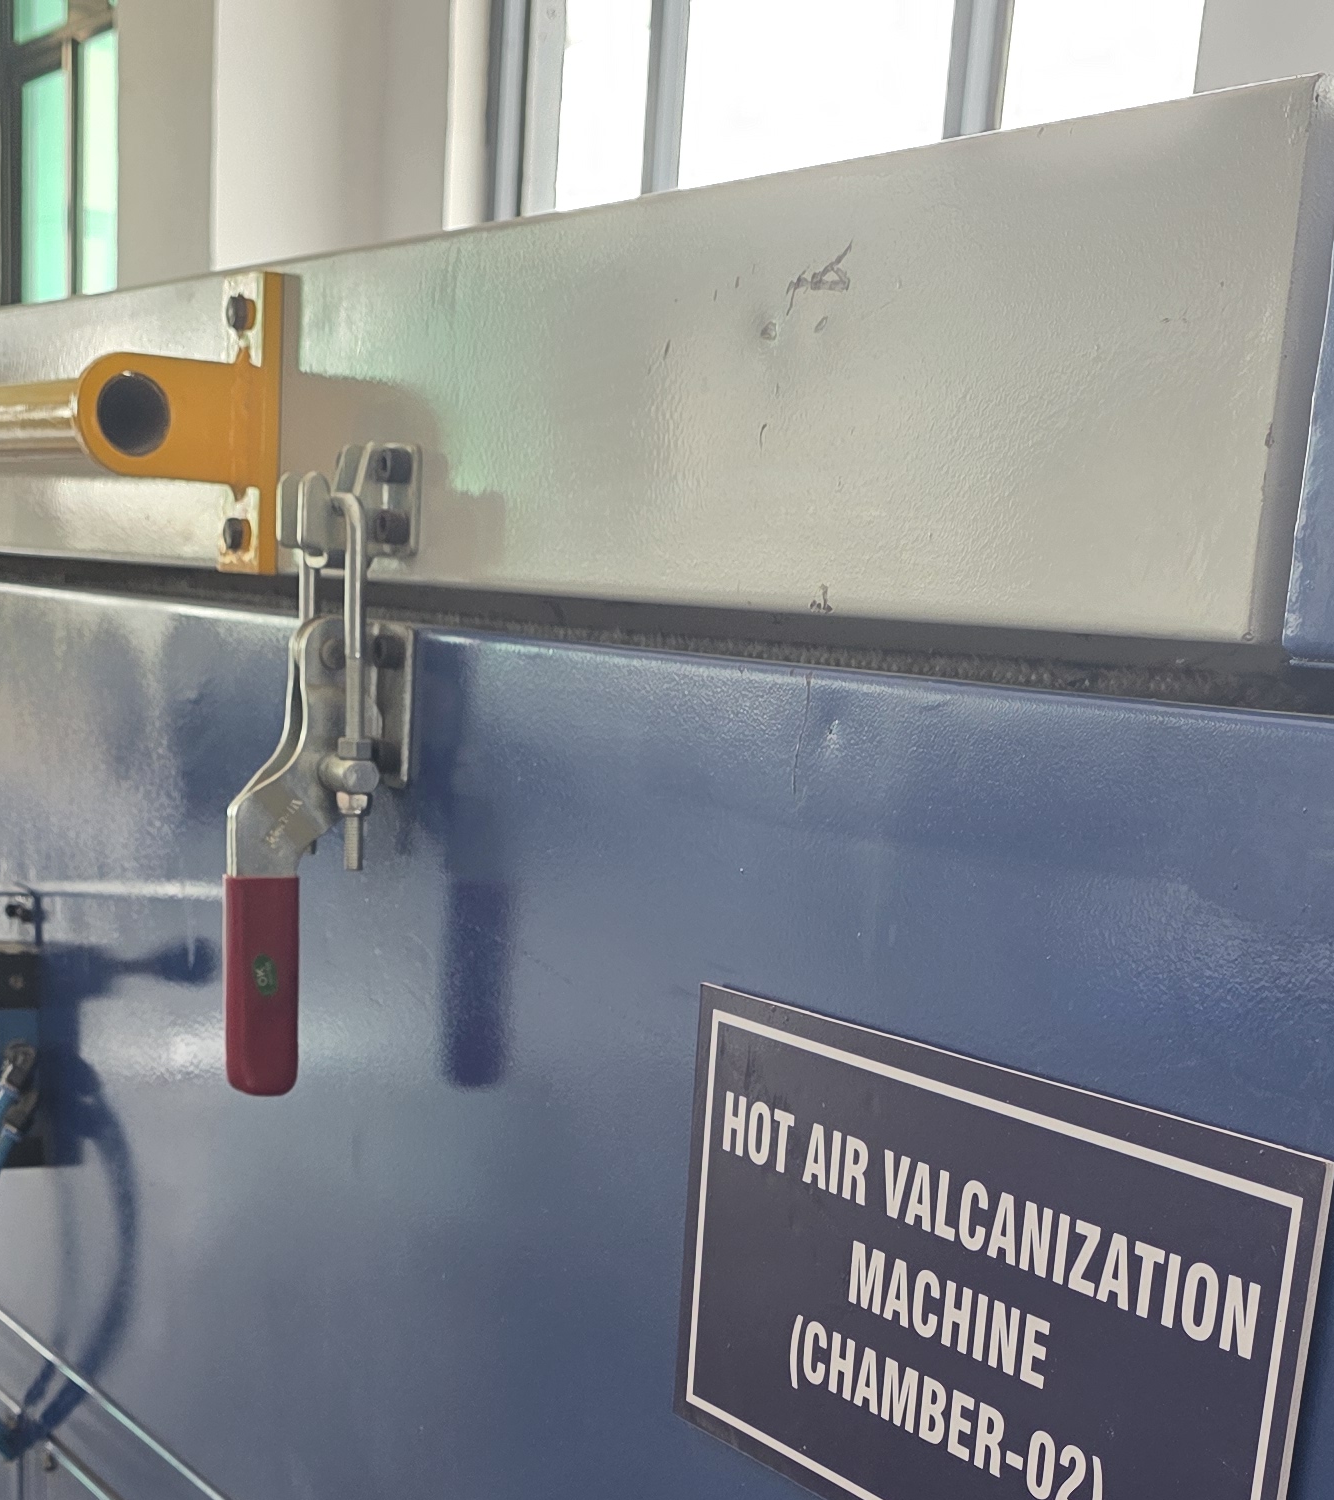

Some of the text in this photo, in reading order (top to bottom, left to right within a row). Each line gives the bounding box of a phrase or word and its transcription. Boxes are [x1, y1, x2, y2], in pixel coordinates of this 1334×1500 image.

[722, 1090, 1263, 1360] HOT AIR VALCANIZATION
[848, 1240, 1051, 1390] MACHINE
